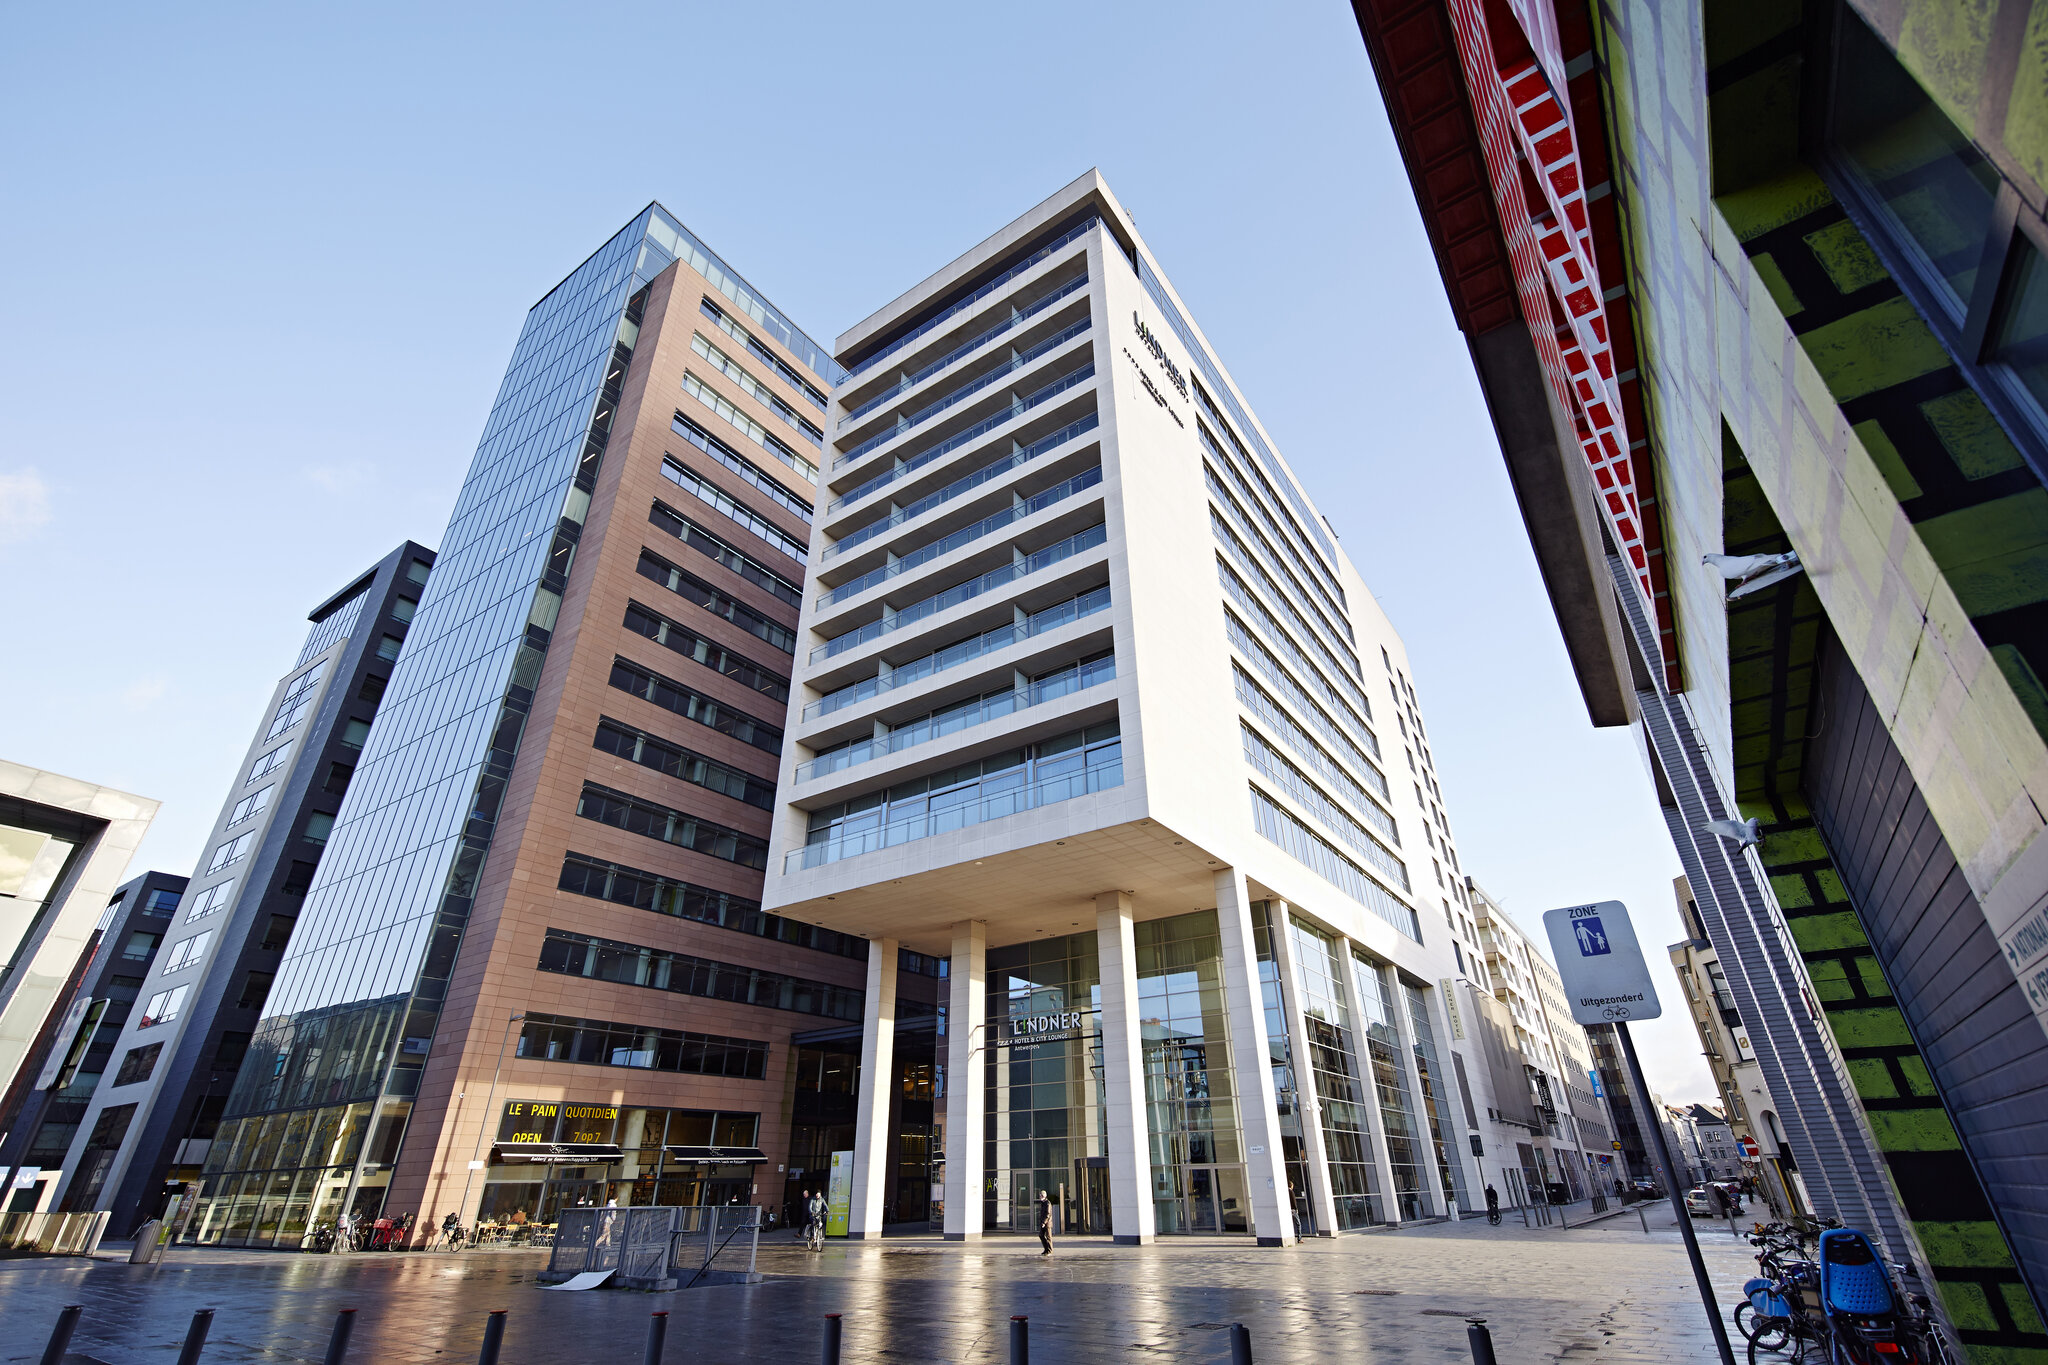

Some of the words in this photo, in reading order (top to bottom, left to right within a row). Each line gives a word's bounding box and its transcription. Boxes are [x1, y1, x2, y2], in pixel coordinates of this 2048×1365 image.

[1567, 905, 1598, 919] ZONE
[1580, 992, 1644, 1007] Uitgezonderd
[1444, 980, 1455, 1011] LINDNER
[1452, 1015, 1461, 1038] HOTEL
[1014, 1036, 1030, 1044] HOTEL
[509, 1104, 522, 1115] LE
[531, 1105, 557, 1117] PAIN
[565, 1106, 618, 1120] QUOTIDIEN
[512, 1133, 542, 1143] OPEN
[573, 1131, 580, 1143] 7
[581, 1132, 593, 1144] op
[594, 1132, 601, 1143] 7
